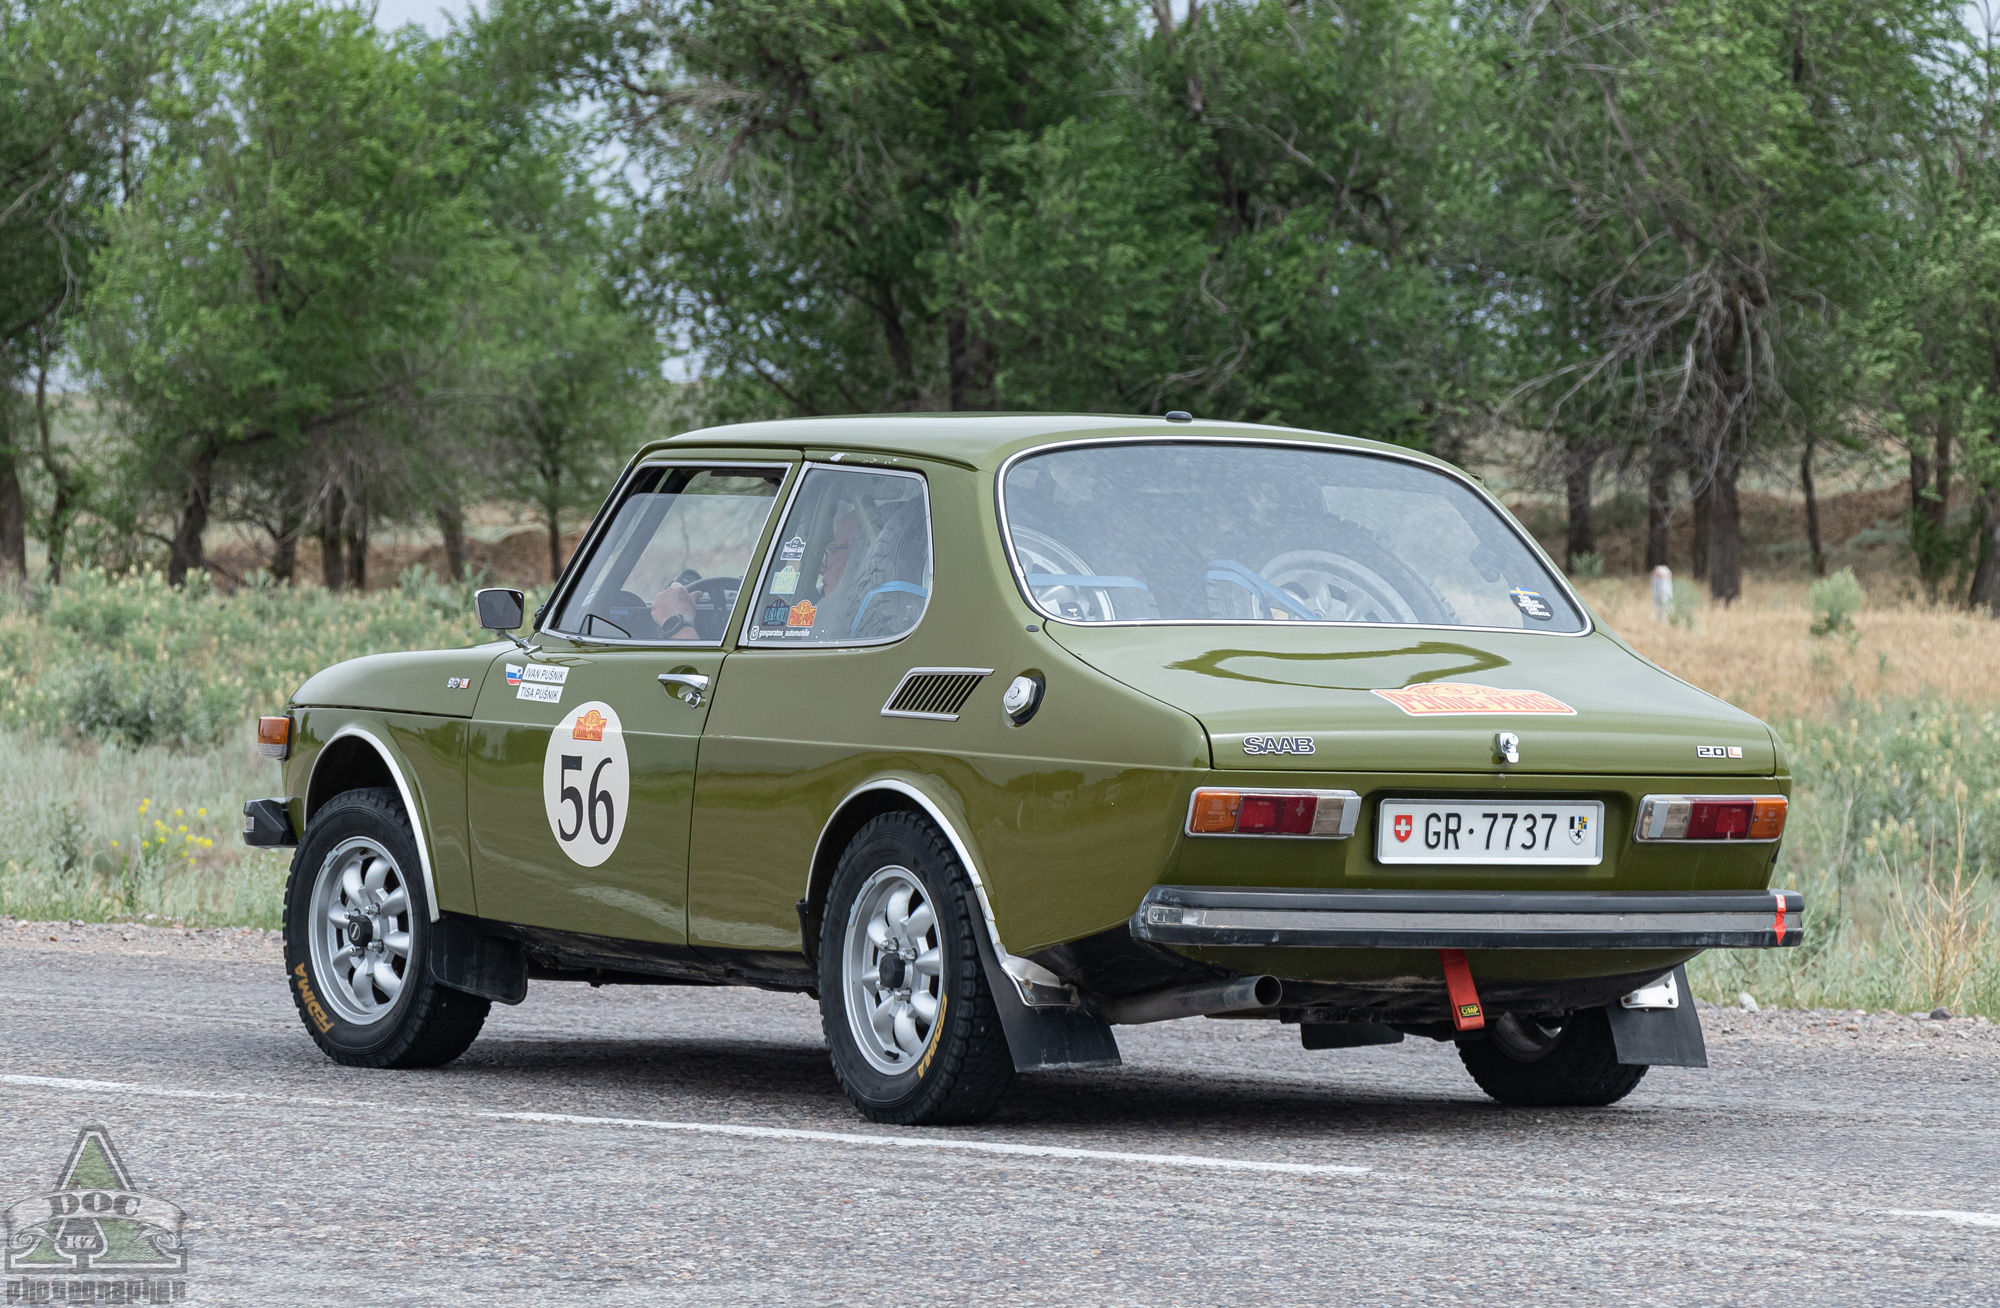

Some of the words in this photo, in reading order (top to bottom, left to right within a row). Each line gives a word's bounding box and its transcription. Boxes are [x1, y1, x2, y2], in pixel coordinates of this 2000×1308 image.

[526, 668, 540, 679] IVAN
[520, 686, 534, 698] TISA
[1385, 692, 1484, 710] PEKING
[1491, 692, 1566, 711] PARIS
[1243, 735, 1316, 755] SAAB
[558, 754, 615, 845] 56
[294, 962, 335, 1034] FEDIMA
[1461, 1006, 1479, 1015] OMP
